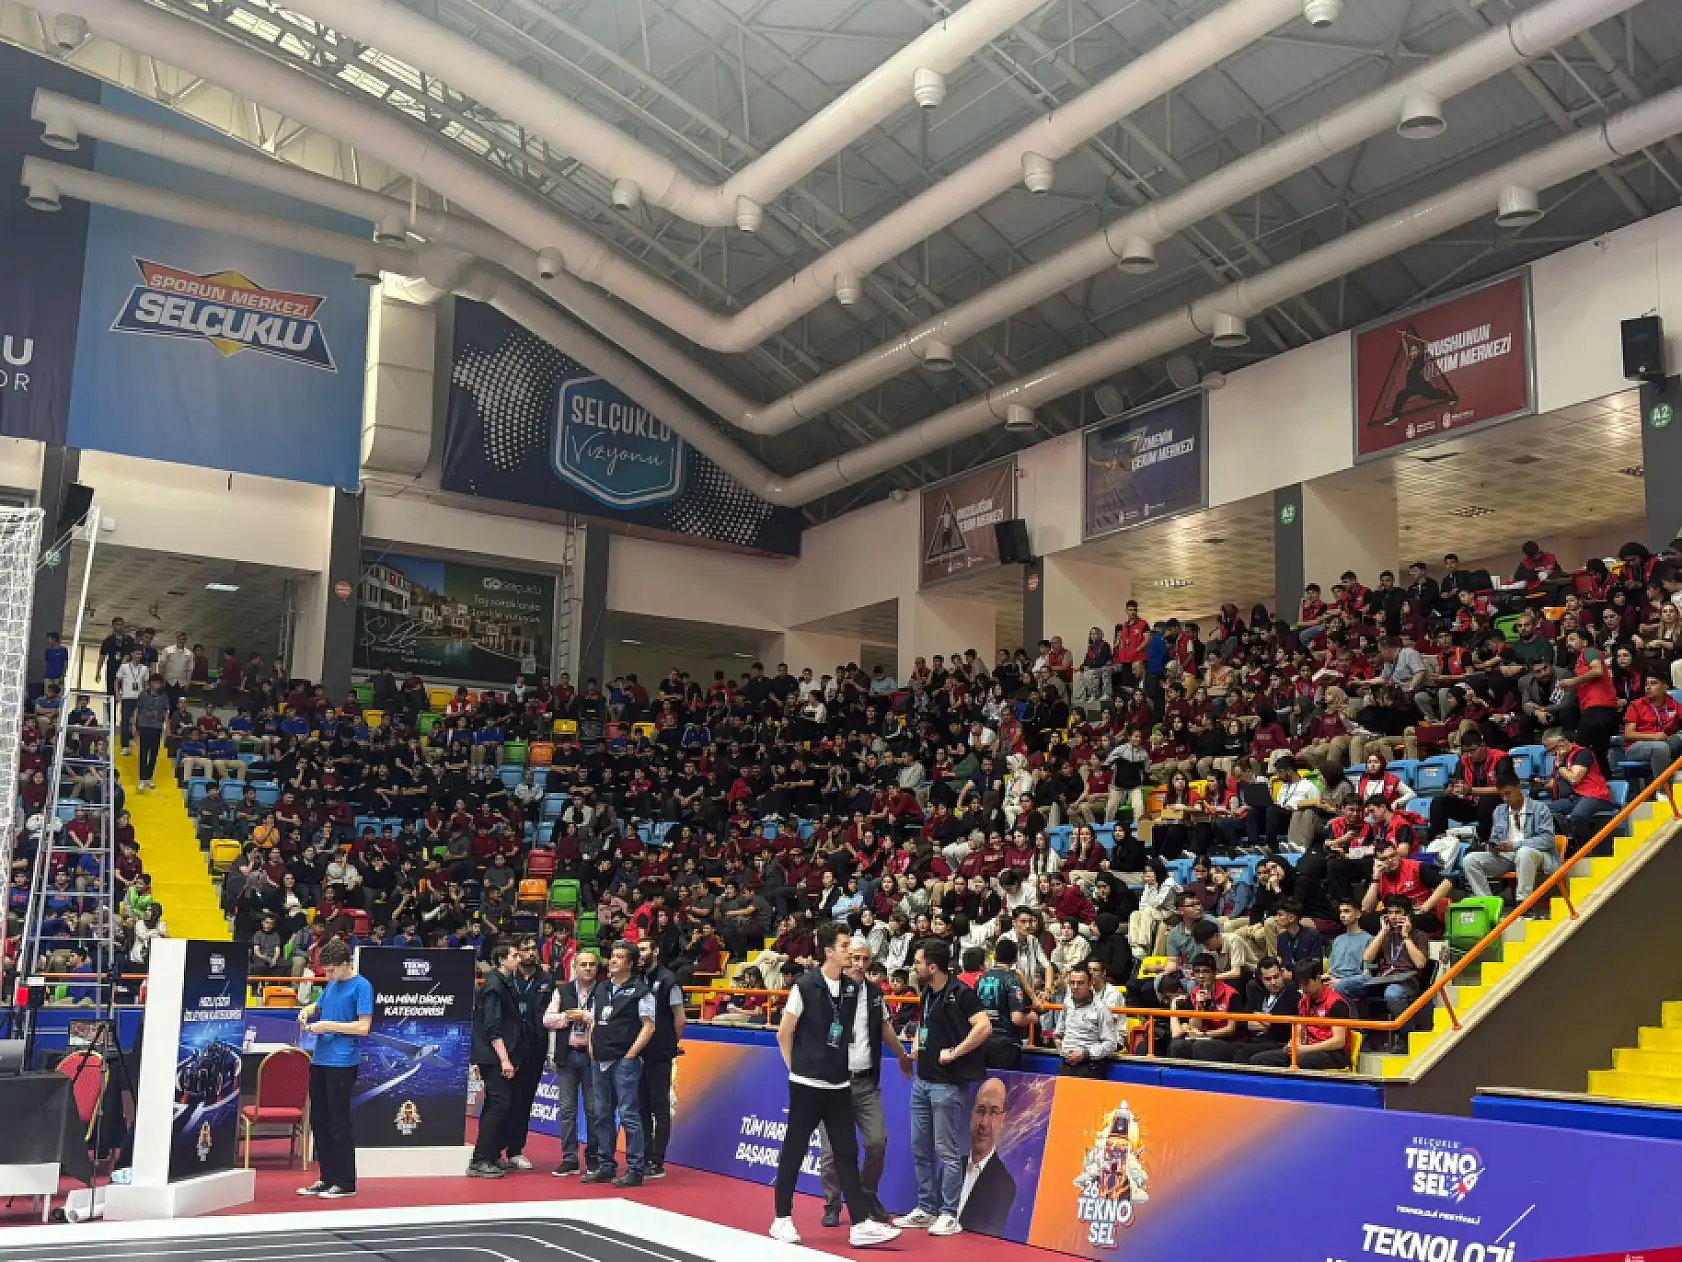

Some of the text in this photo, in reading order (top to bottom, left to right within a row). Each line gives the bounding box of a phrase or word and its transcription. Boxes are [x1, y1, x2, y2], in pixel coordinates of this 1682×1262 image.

[150, 274, 308, 318] SPORUN MERKEZİ
[1459, 332, 1512, 368] MERKEZİ
[571, 394, 671, 442] SELÇUKLU
[571, 431, 664, 476] Vizyonu
[419, 994, 455, 1006] DRONE
[740, 1114, 763, 1137] TÜM
[1404, 1147, 1477, 1176] TEKNO
[1083, 1180, 1100, 1198] 26
[1412, 1171, 1449, 1197] SEL
[1077, 1197, 1133, 1223] TEKNO
[1088, 1221, 1115, 1245] SEL
[1361, 1222, 1516, 1262] TEKNOLOJİ
